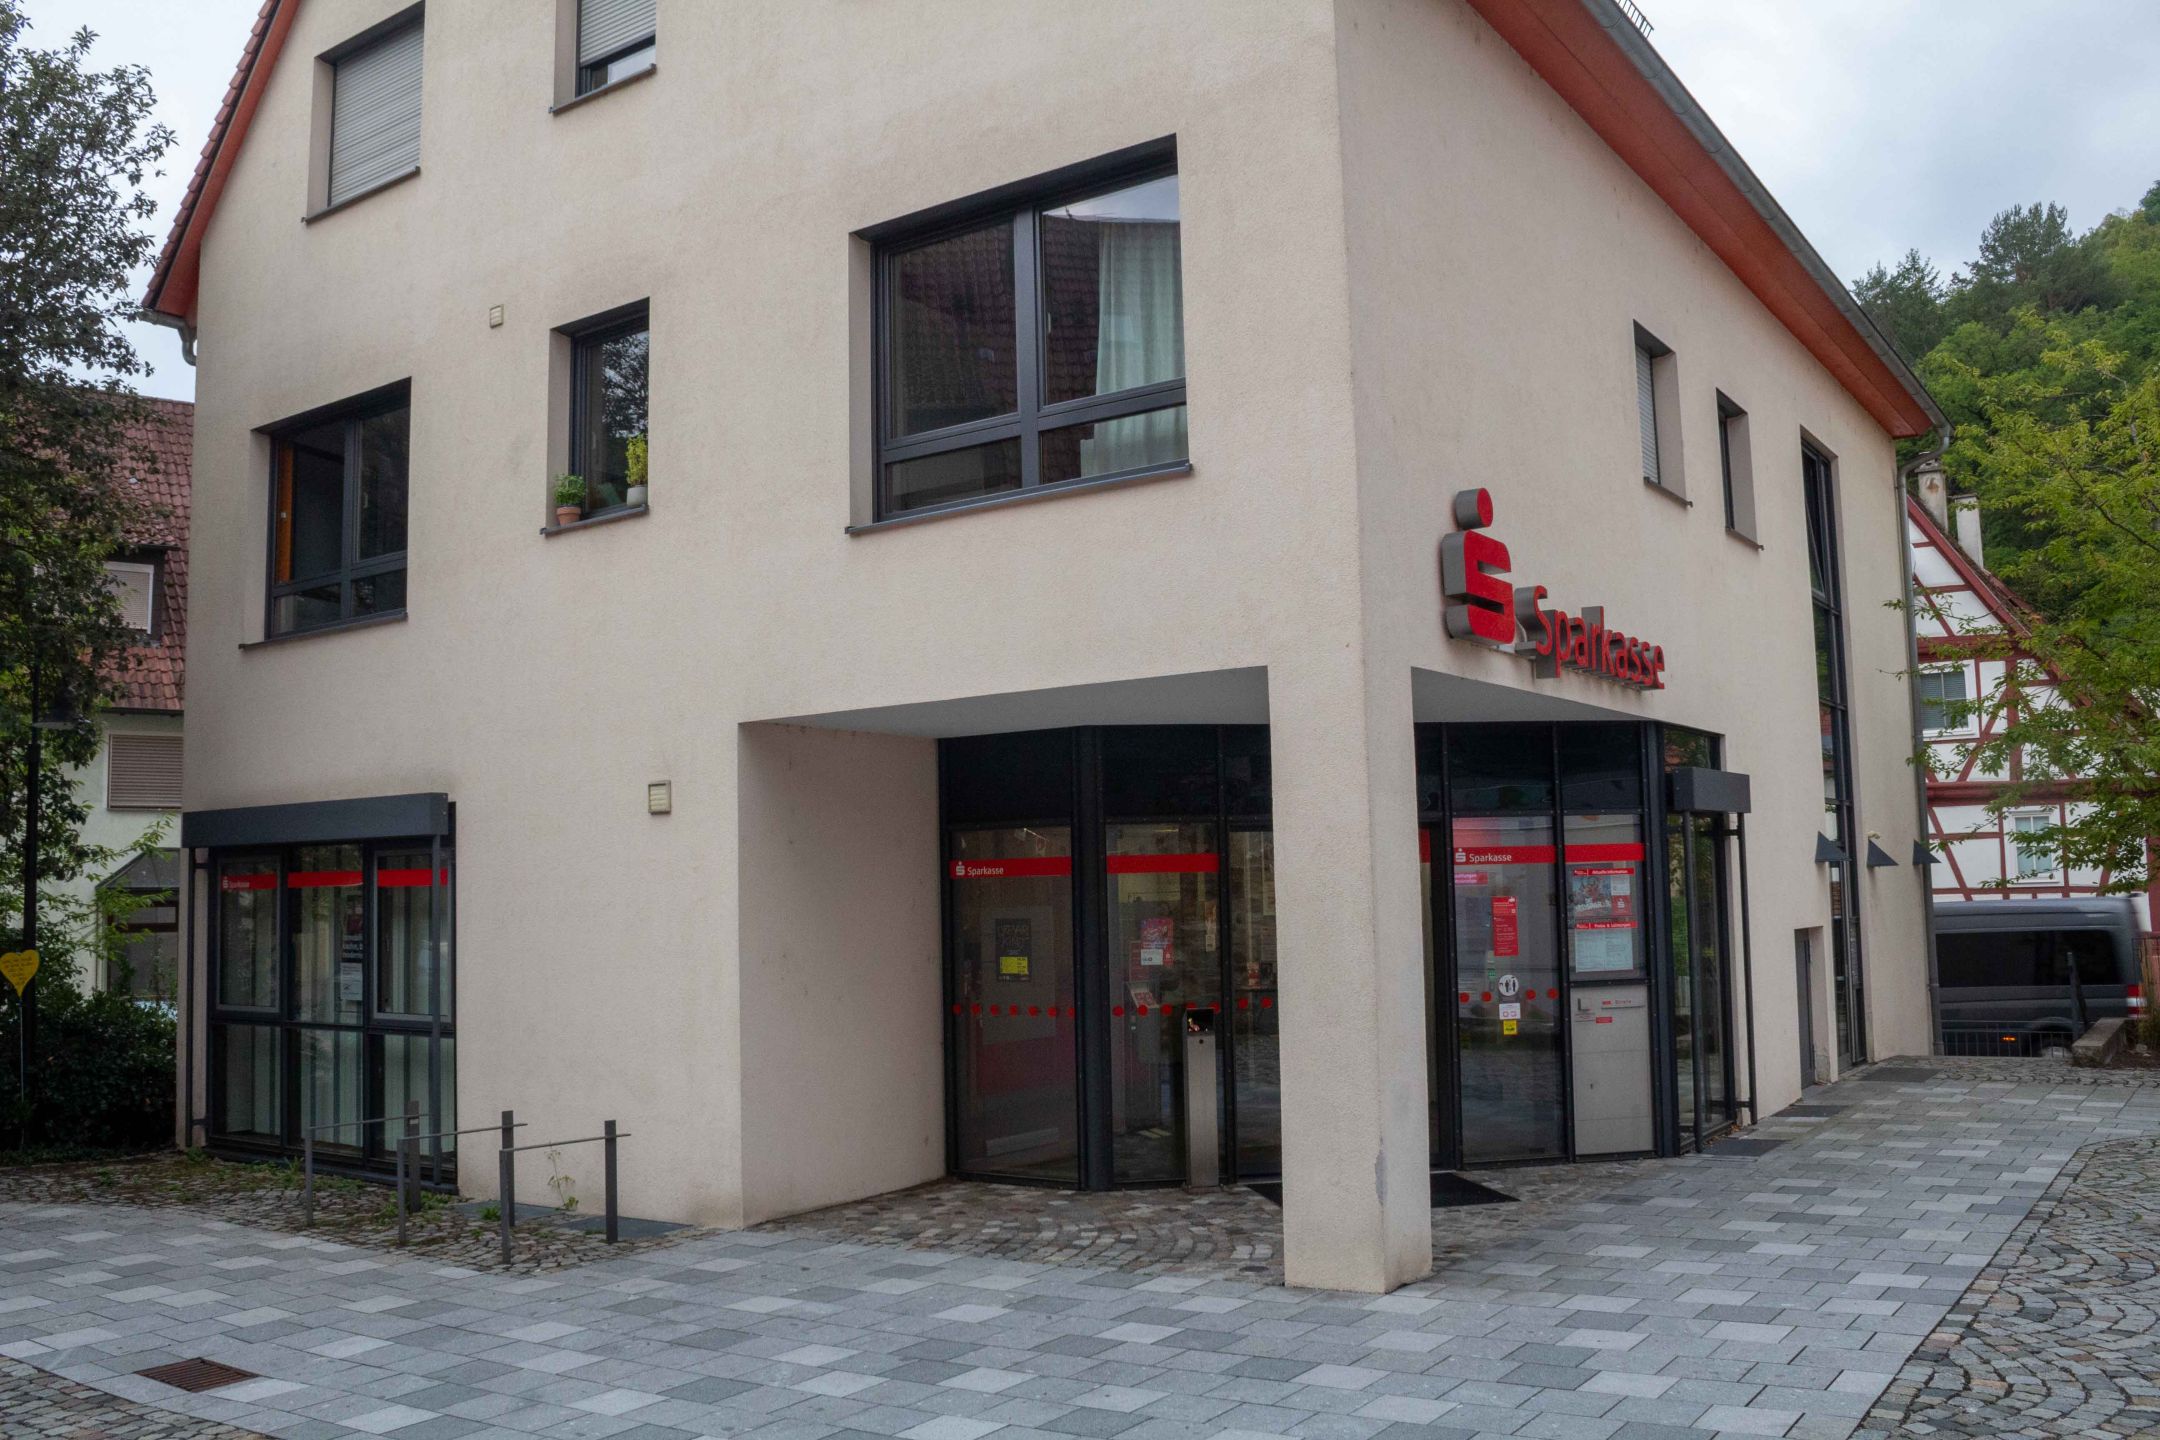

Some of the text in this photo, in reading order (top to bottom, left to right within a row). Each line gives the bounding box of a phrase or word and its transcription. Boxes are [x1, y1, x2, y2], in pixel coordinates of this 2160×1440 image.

[1517, 585, 1665, 689] Sparkasse
[1469, 853, 1512, 863] Sparkasse
[967, 867, 1004, 877] Sparkasse
